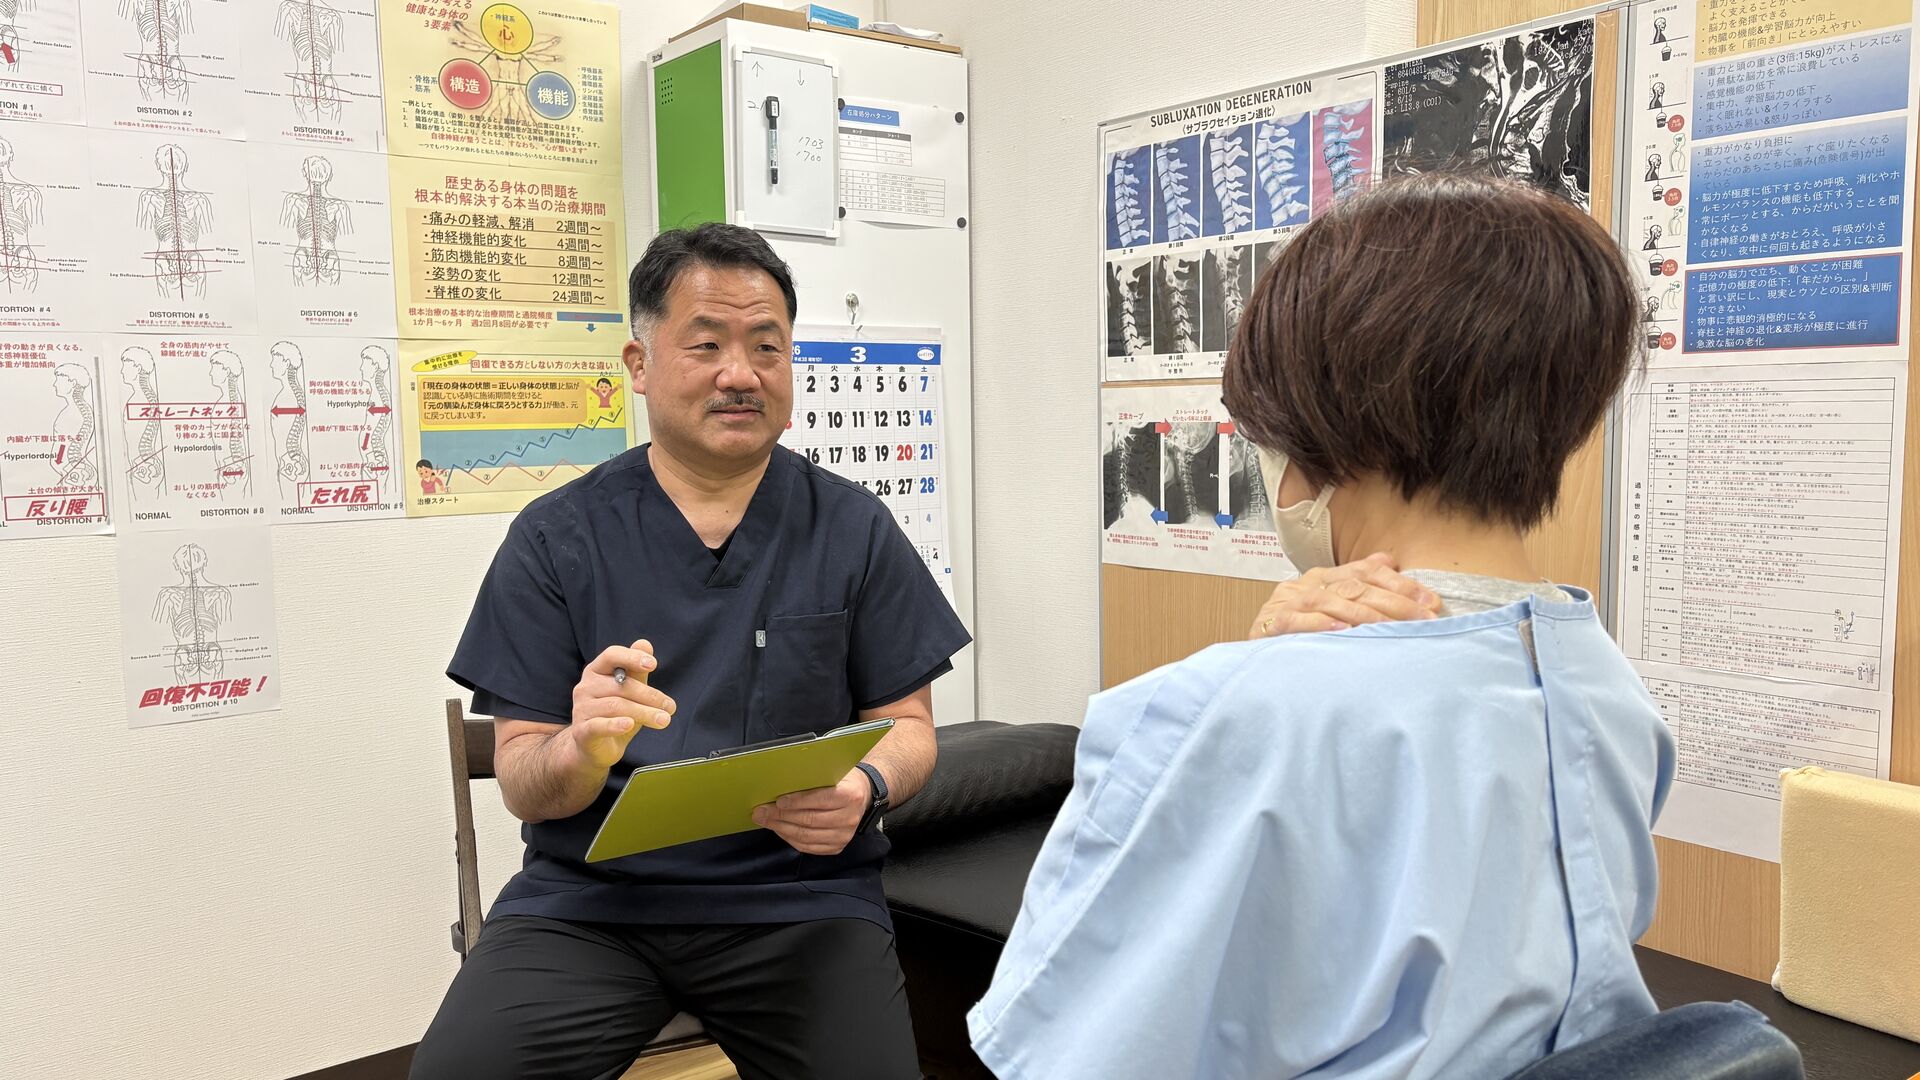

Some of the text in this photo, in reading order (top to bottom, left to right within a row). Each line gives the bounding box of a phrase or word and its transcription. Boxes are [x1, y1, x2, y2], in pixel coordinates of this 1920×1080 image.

[405, 2, 469, 20] 健康な身体の
[423, 20, 452, 32] 3要素
[1708, 9, 1788, 33] 脳力を発揮できる
[499, 25, 515, 40] 心
[1708, 11, 1837, 44] 内臓の機能&学習脳力が向上
[1708, 20, 1862, 56] 物事を「前向き」にとらえやすい
[1708, 53, 1860, 88] り無駄な脳力を常に浪費している
[415, 75, 438, 84] 骨格系
[450, 76, 480, 94] 構造
[415, 84, 431, 93] 筋系
[1707, 79, 1776, 100] 感覚機能の低下
[538, 87, 569, 106] 機能
[1706, 84, 1816, 111] 集中力、学習脳力の低下
[402, 100, 432, 108] 一例として
[1150, 80, 1312, 128] SUBLUXATION DEGENERATION
[1706, 94, 1832, 122] よく眠れない&イライラする
[137, 106, 179, 116] DISTORTION
[1705, 109, 1822, 134] 落ち込み易い&怒りっぽい
[293, 126, 332, 135] DISTORTION
[798, 136, 824, 150] 1703
[1704, 136, 1793, 157] 重力がかなり負担に
[1704, 134, 1890, 168] 立っているのが辛く、すぐ座りたくなる
[445, 175, 579, 200] 歴史ある身体の問題を
[1701, 170, 1900, 203] 脳力が極度に低下するため呼吸、消化やホ
[1704, 180, 1731, 191] ている
[415, 188, 606, 217] 根本的解決する本当の治療期間
[1702, 188, 1855, 213] ルモンバランスの機能も低下する
[1700, 221, 1886, 248] 自律神経の働きがおとろえ、呼吸が小さ
[1701, 223, 1749, 236] かなくなる
[1701, 233, 1886, 258] くなり、夜中に何回も起きるようになる
[1699, 259, 1863, 281] 自分の脳力で立ち、動くことが困難
[408, 307, 553, 320] 根本治療の基本的な治療期間と通院頻度
[1697, 305, 1746, 315] ができない
[1697, 310, 1816, 327] 物事に悲観的消極的になる
[1697, 319, 1868, 337] 脊柱と神経の退化&変形が極度に進行
[0, 343, 83, 352] 骨の動きが良くなる。
[1696, 337, 1765, 349] 急激な脳の老化
[160, 350, 207, 358] 繊維化が進む
[850, 346, 867, 363] 3
[471, 359, 619, 370] 回復できる方としない方の大きな違い！
[309, 380, 363, 388] 胸の幅が狭くなり
[806, 375, 928, 393] 2 3 4 5 6 7
[309, 387, 371, 395] 呼吸の機能が落ちる
[423, 391, 542, 400] 認識している時に施術期間を空けると
[327, 400, 375, 408] Hyperkyphosis
[139, 406, 238, 417] ストレートネック
[424, 411, 486, 420] に戻ってしまいます。
[1118, 412, 1144, 421] 正常カーブ
[807, 410, 933, 428] 9 10 11 12 13 14
[174, 424, 251, 432] 背骨のカーブがなくな
[7, 435, 82, 443] 内臓が下腹に落ちる
[174, 444, 222, 453] Hypolordosis
[805, 444, 933, 464] 16 17 18 19 20 21
[4, 453, 57, 461] Hyperlordosi
[28, 485, 103, 494] 土台の傾きが大きい
[174, 483, 228, 491] おしりの筋肉が
[876, 480, 891, 496] 26
[898, 478, 913, 494] 27
[920, 477, 935, 493] 28
[186, 491, 216, 499] なくなる
[311, 485, 371, 504] たれ尻
[347, 503, 391, 512] DISTORTION
[417, 497, 459, 506] 治療スタート
[26, 498, 89, 518] 反り腰
[200, 508, 249, 517] DISTORTION
[281, 507, 314, 516] NORMAL
[37, 517, 92, 526] DISTORTION
[135, 511, 171, 520] NORMAL
[904, 513, 931, 524] 3 4
[933, 551, 939, 560] 4
[139, 676, 267, 709] 回復不可能！
[172, 700, 220, 712] DISTORTION
